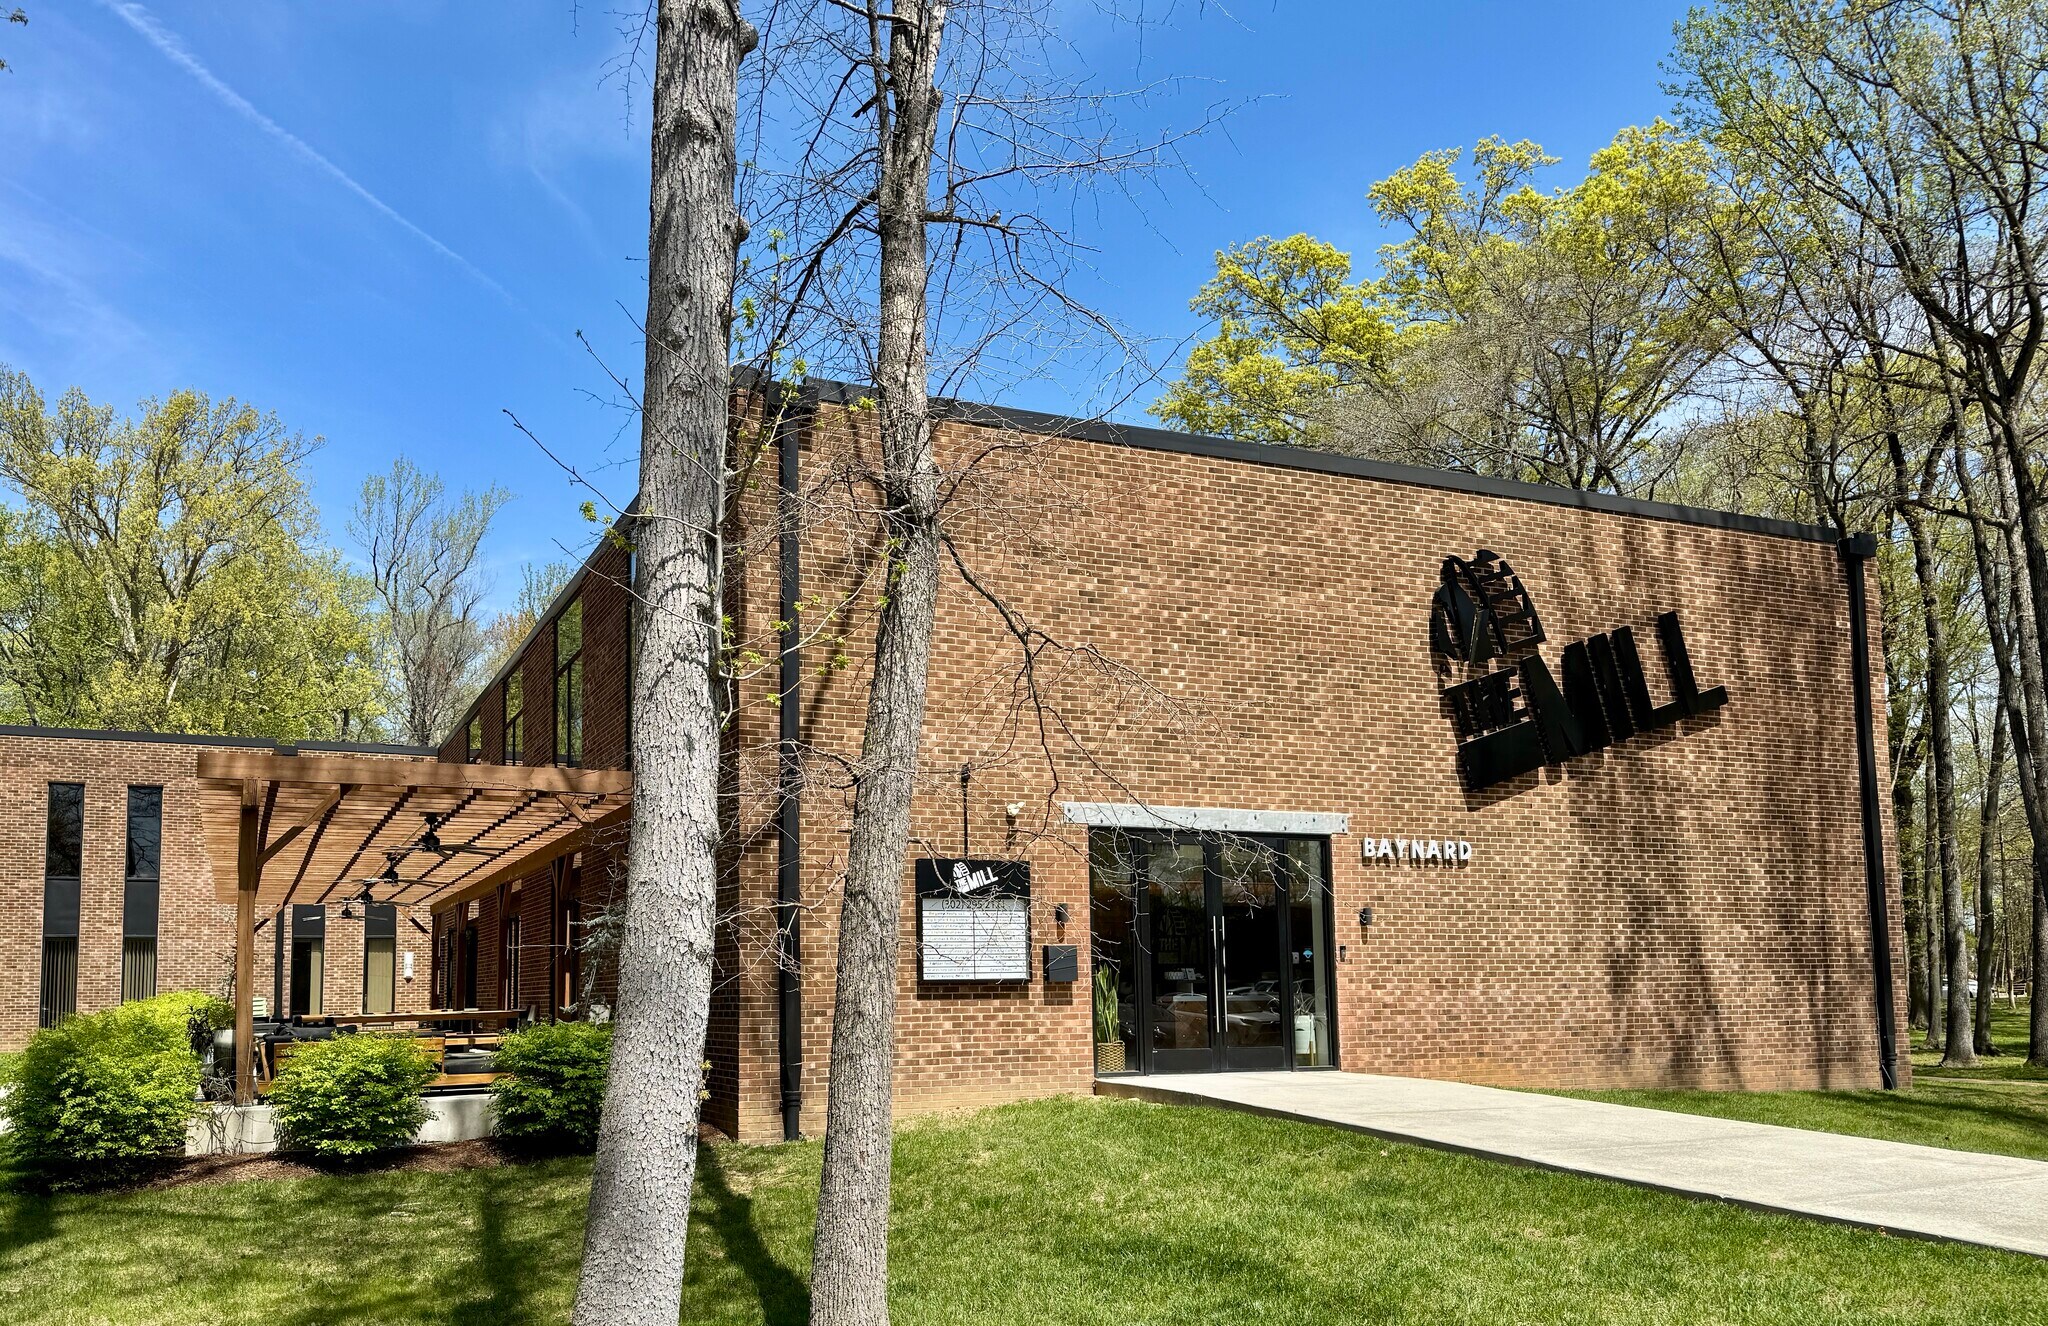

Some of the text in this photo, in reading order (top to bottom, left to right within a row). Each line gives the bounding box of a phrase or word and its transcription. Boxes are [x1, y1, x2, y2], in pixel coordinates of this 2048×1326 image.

[1442, 610, 1730, 766] THE MILL
[1364, 838, 1474, 862] BAYNARD
[965, 867, 998, 890] MILL
